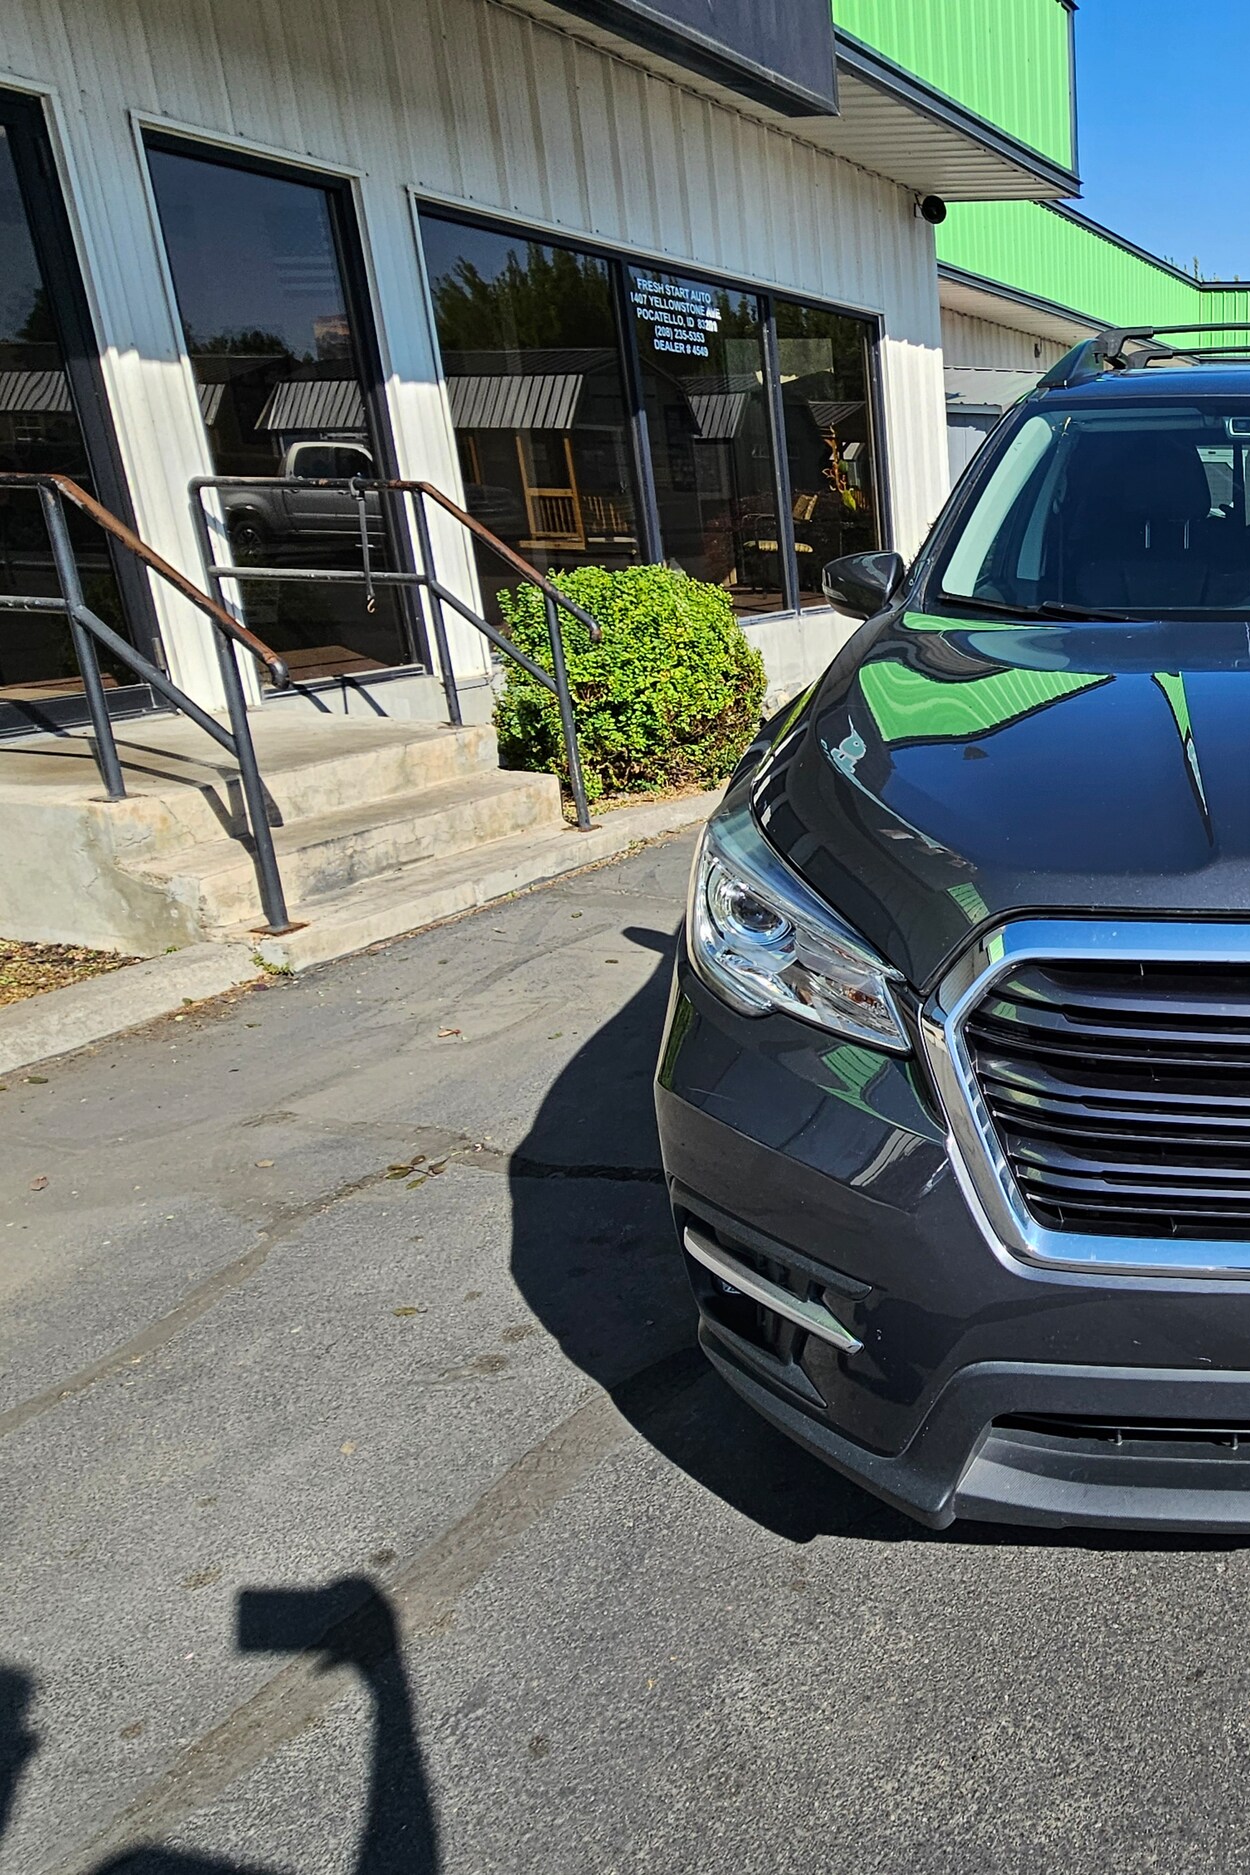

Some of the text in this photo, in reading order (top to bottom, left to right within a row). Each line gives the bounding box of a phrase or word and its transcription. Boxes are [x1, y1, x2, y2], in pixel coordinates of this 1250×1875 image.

[630, 291, 647, 305] 1407
[649, 295, 705, 315] YELLOWSTONE
[637, 278, 711, 304] FRESH START AUTO
[637, 308, 718, 332] POCATELLO, ID 83201
[654, 325, 705, 343] (208) 235-5353
[654, 340, 685, 353] DEALER
[692, 345, 709, 357] 4549
